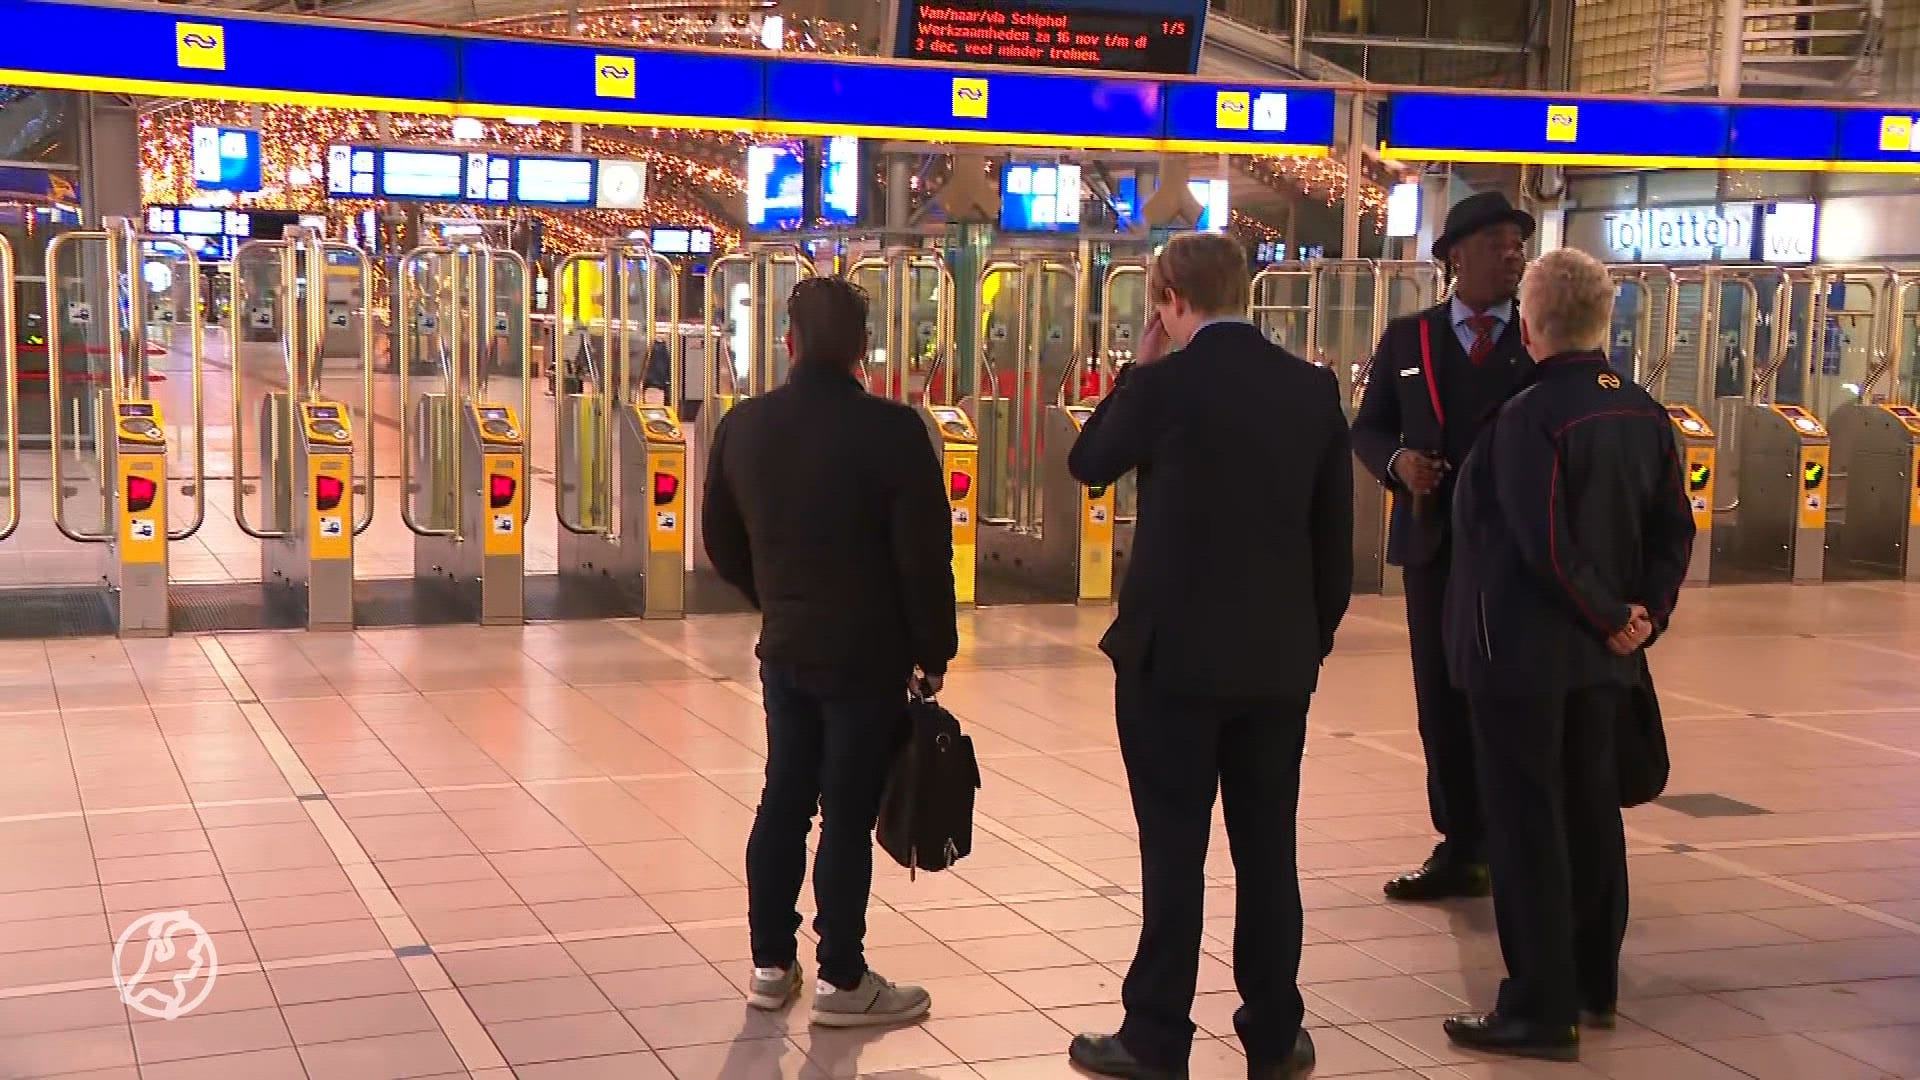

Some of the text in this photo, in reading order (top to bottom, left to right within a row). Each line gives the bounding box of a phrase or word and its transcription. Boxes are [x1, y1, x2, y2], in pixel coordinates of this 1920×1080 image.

[919, 5, 1069, 29] Van/naar/via Schiphol
[1161, 20, 1186, 36] 1/5
[917, 21, 1031, 42] Werkzaamheden
[1035, 32, 1051, 43] za
[1056, 30, 1071, 44] 16
[1075, 34, 1100, 46] nov
[1103, 33, 1130, 48] t/m
[915, 37, 924, 52] 3
[965, 43, 993, 56] veel
[998, 44, 1044, 59] minder
[1603, 208, 1742, 249] Toiletten
